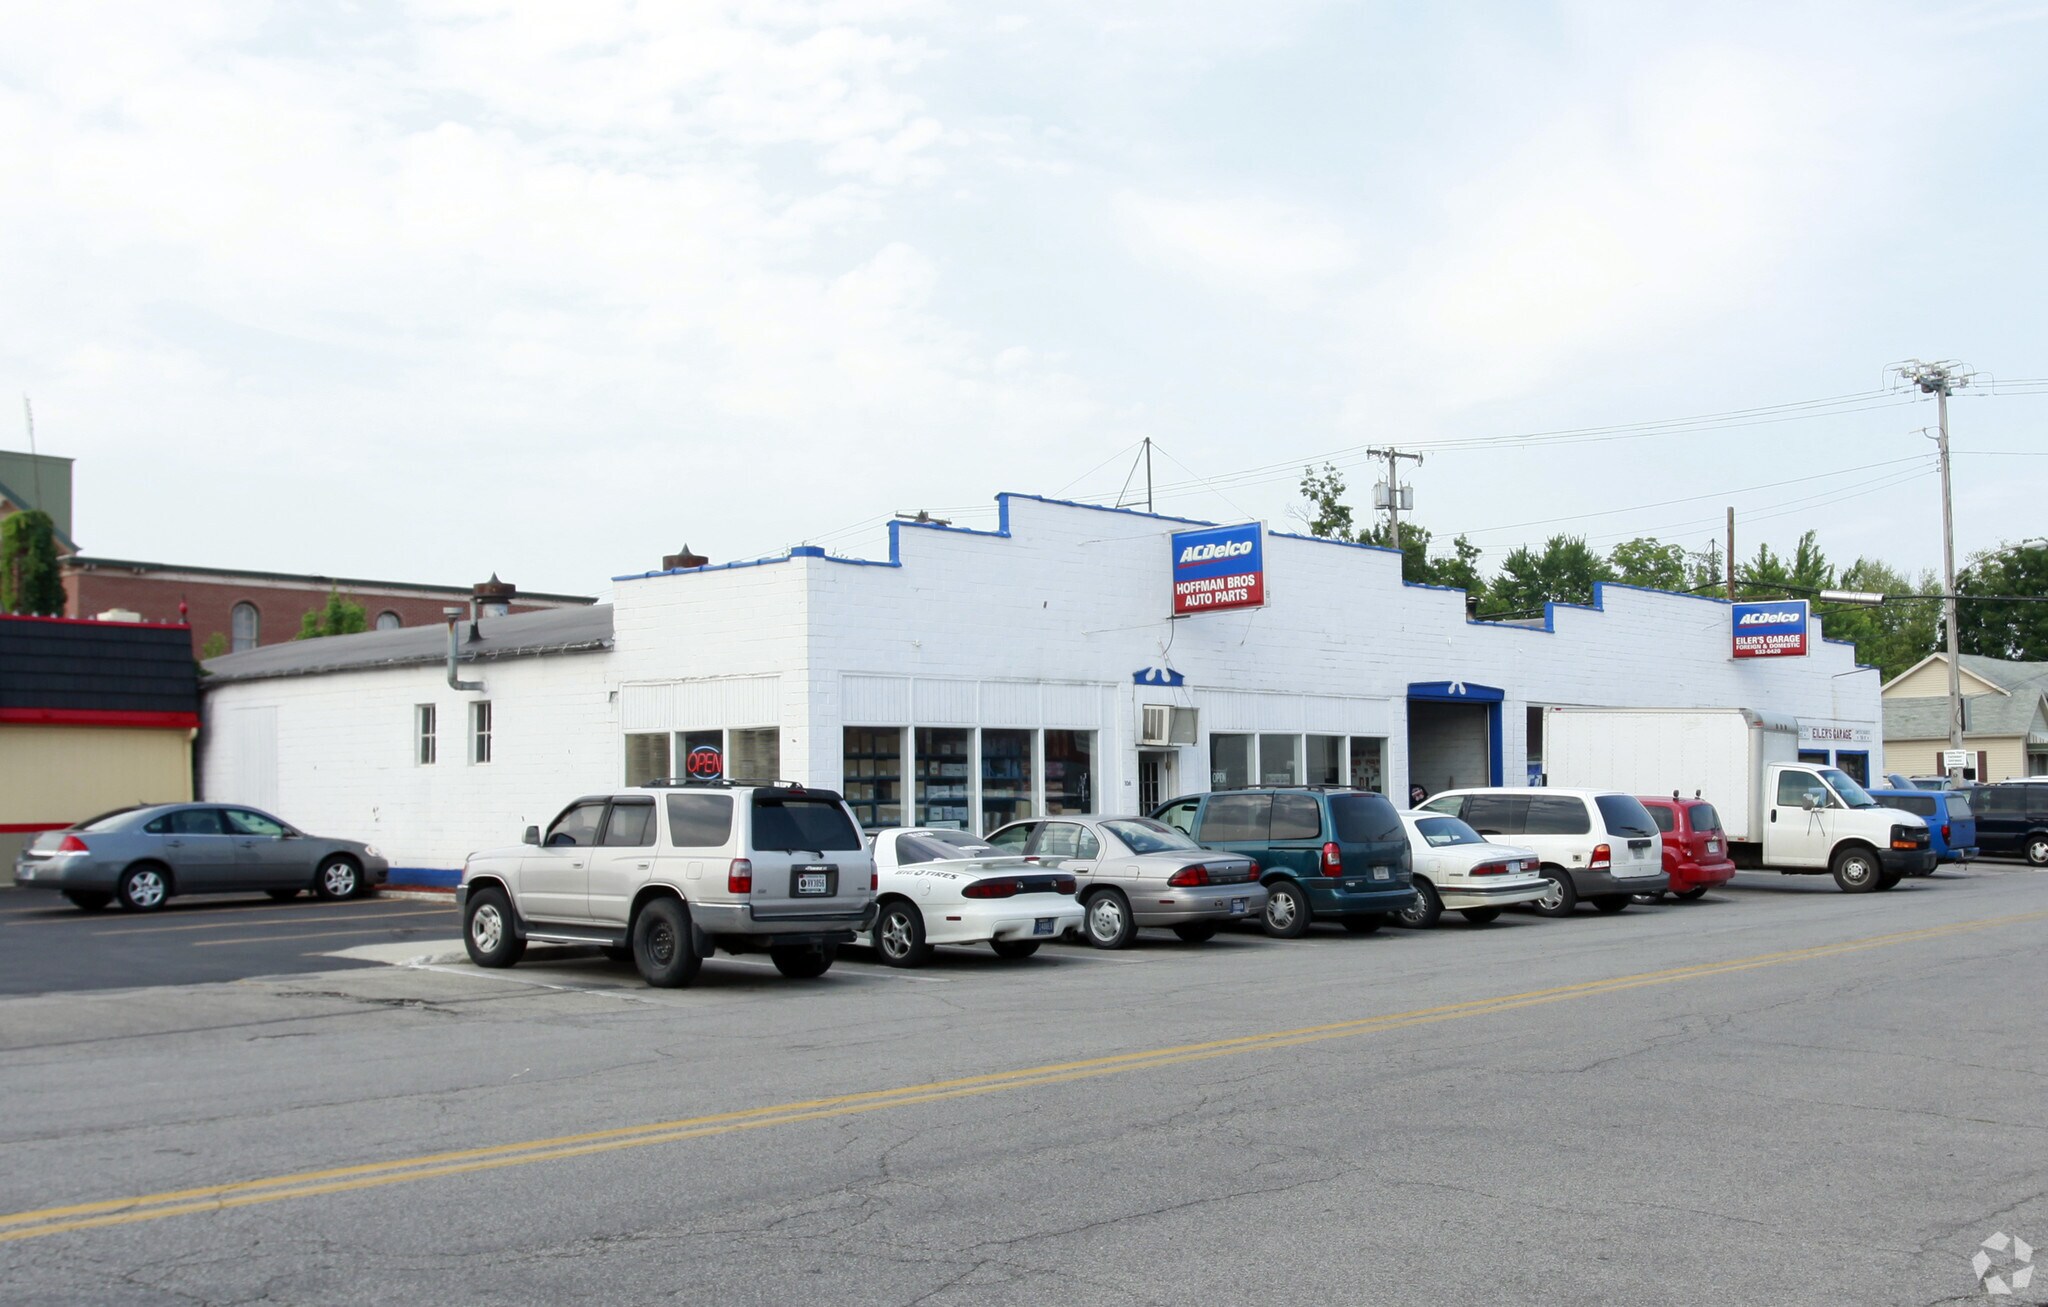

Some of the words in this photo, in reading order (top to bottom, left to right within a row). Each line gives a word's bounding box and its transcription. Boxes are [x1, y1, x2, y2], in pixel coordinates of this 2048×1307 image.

[1179, 541, 1252, 562] ACDelco
[1176, 578, 1224, 594] HOFFMAN
[1227, 574, 1255, 588] BROS
[1185, 593, 1212, 606] AUTO
[1215, 589, 1248, 602] PARTS
[1739, 612, 1799, 624] ACDelco
[1736, 636, 1764, 644] EILER'S
[1766, 635, 1800, 643] GARAGE
[1833, 728, 1852, 740] GARAGE
[686, 752, 723, 774] OPEN
[1212, 772, 1227, 784] OPEN
[925, 871, 960, 880] TIRES
